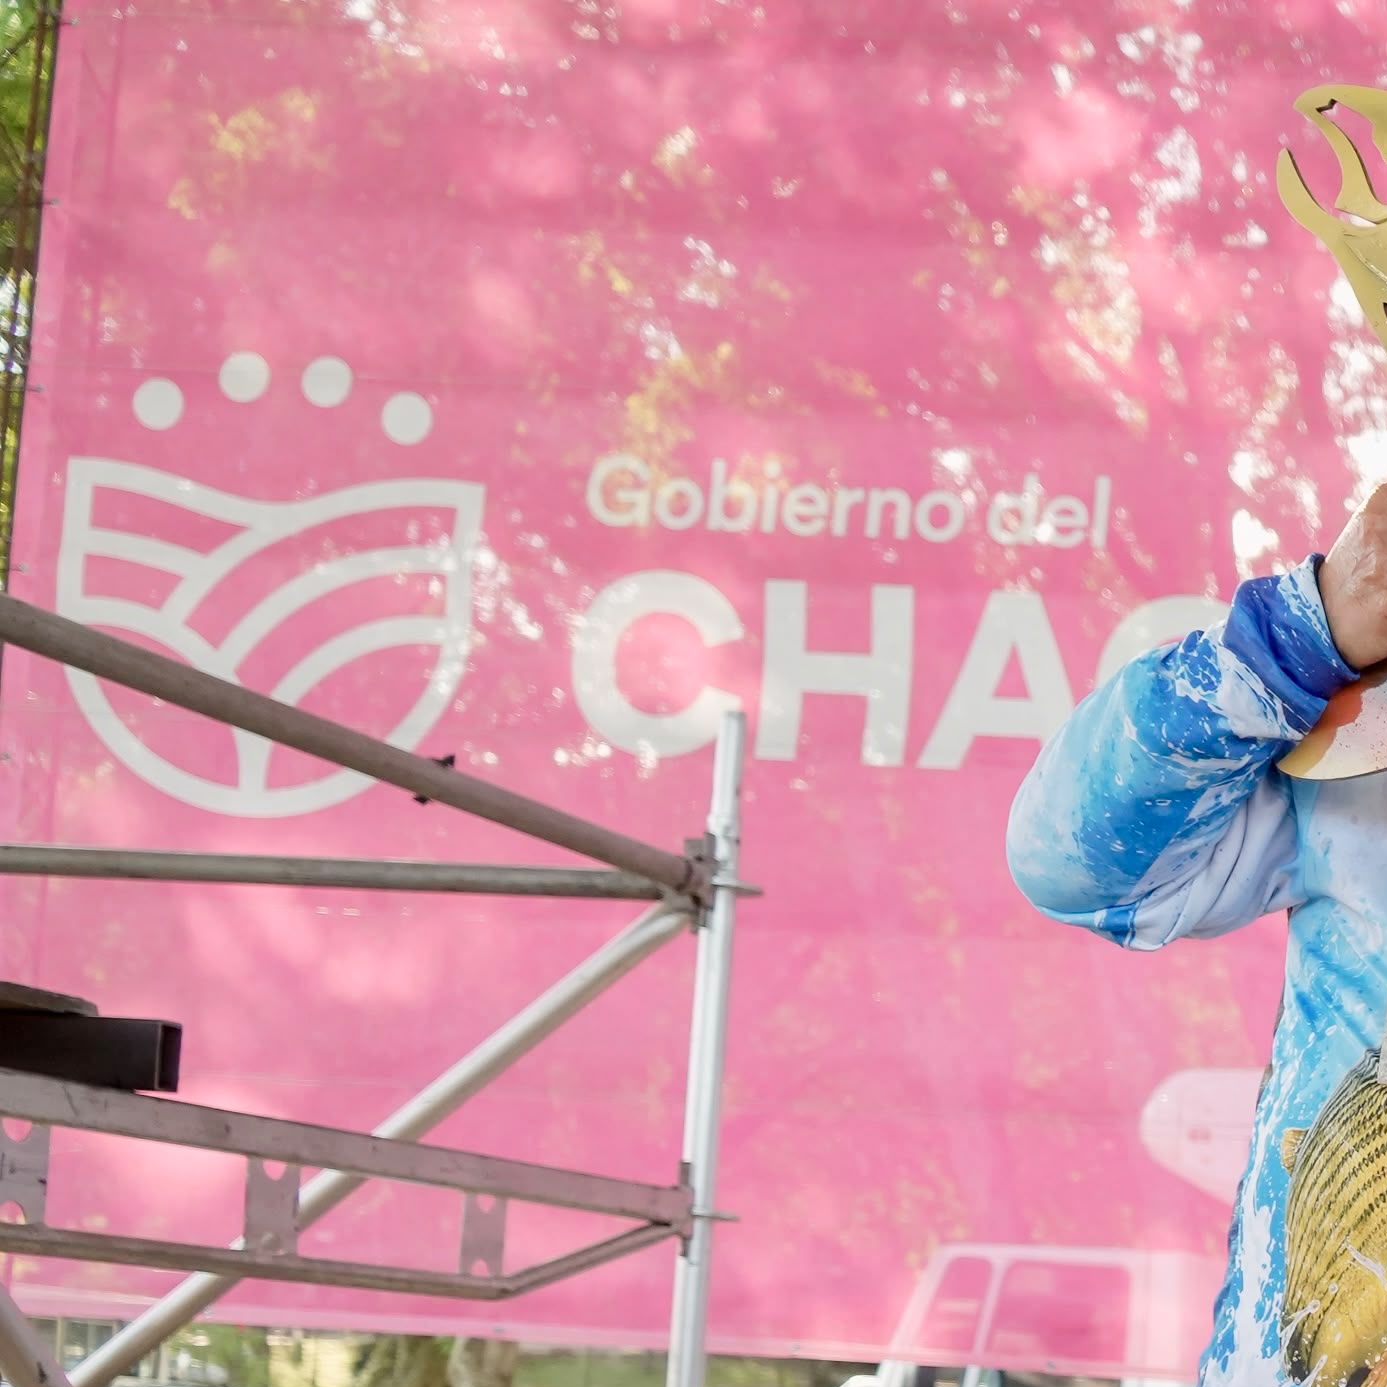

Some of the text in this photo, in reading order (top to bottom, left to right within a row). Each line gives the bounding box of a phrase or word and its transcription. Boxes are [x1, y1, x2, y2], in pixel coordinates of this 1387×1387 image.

[585, 452, 1112, 549] Gobierno del
[571, 568, 1237, 771] CHA
